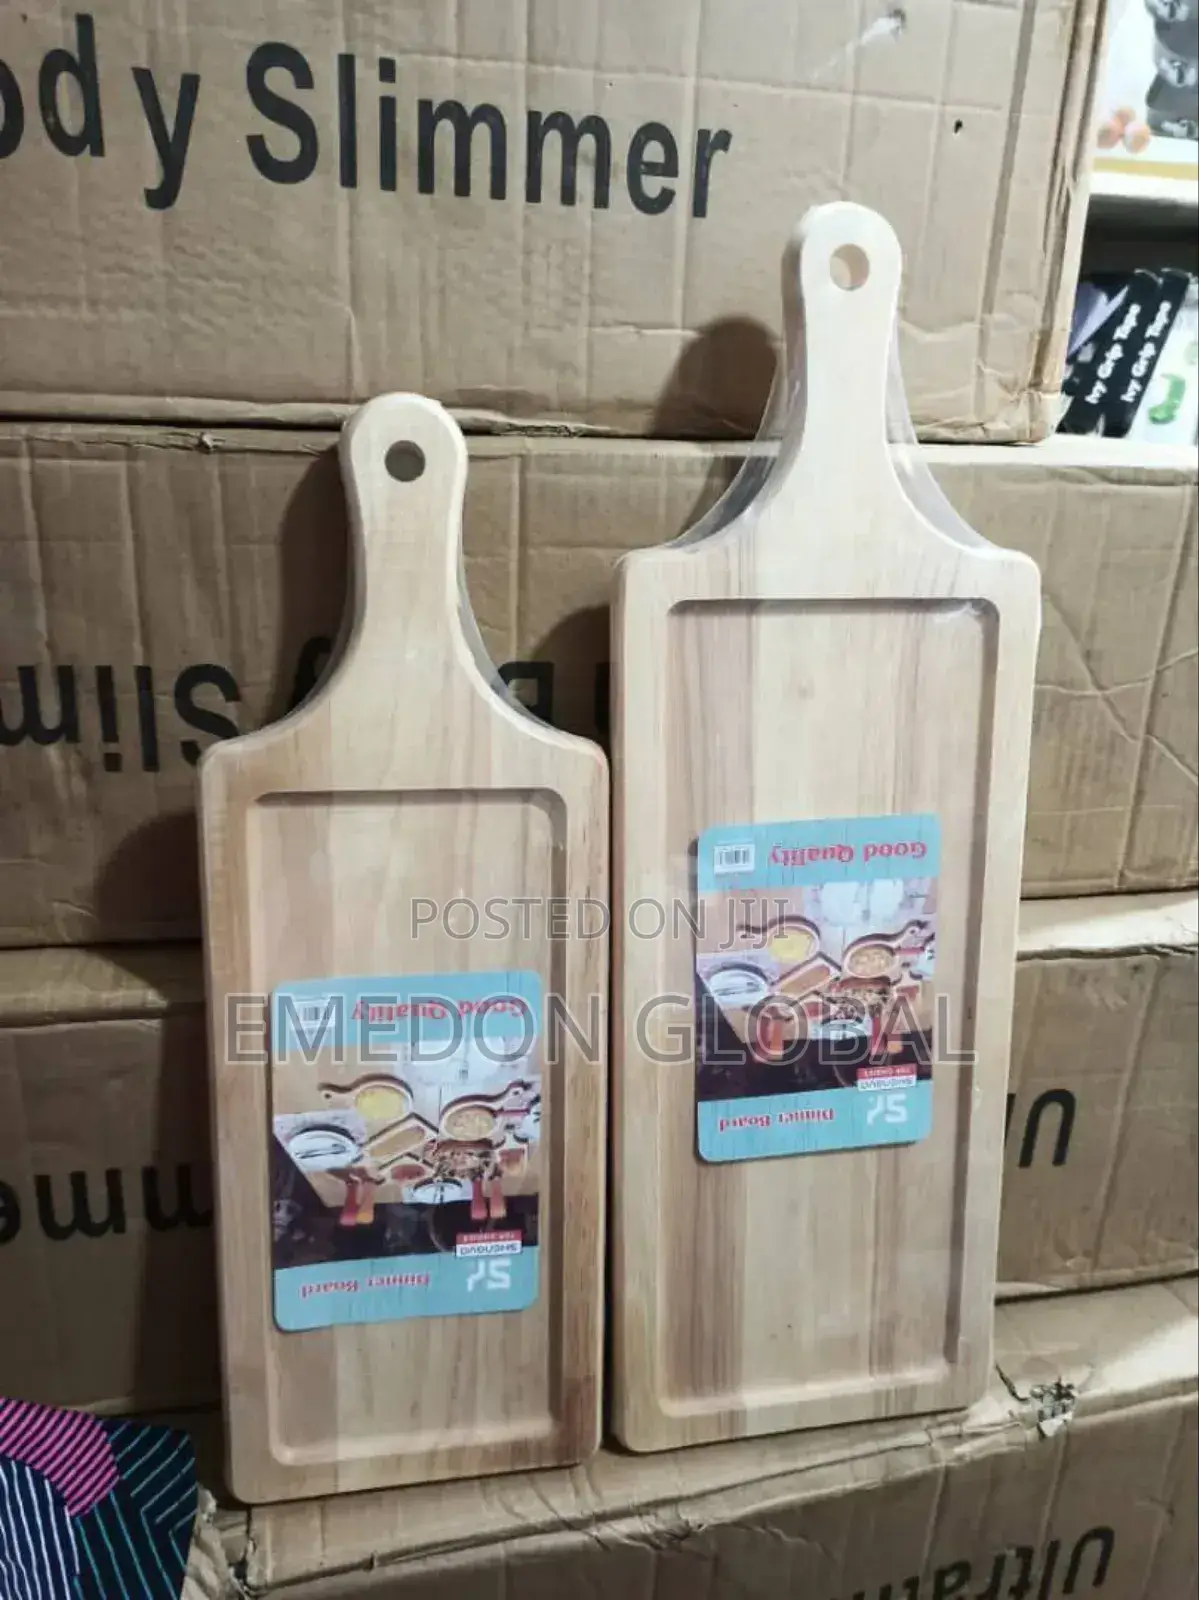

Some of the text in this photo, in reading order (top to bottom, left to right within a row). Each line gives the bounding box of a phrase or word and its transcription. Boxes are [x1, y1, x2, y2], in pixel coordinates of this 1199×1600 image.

[244, 41, 733, 219] Slimmer
[768, 840, 928, 867] Good Quality
[350, 996, 528, 1024] Good Quality
